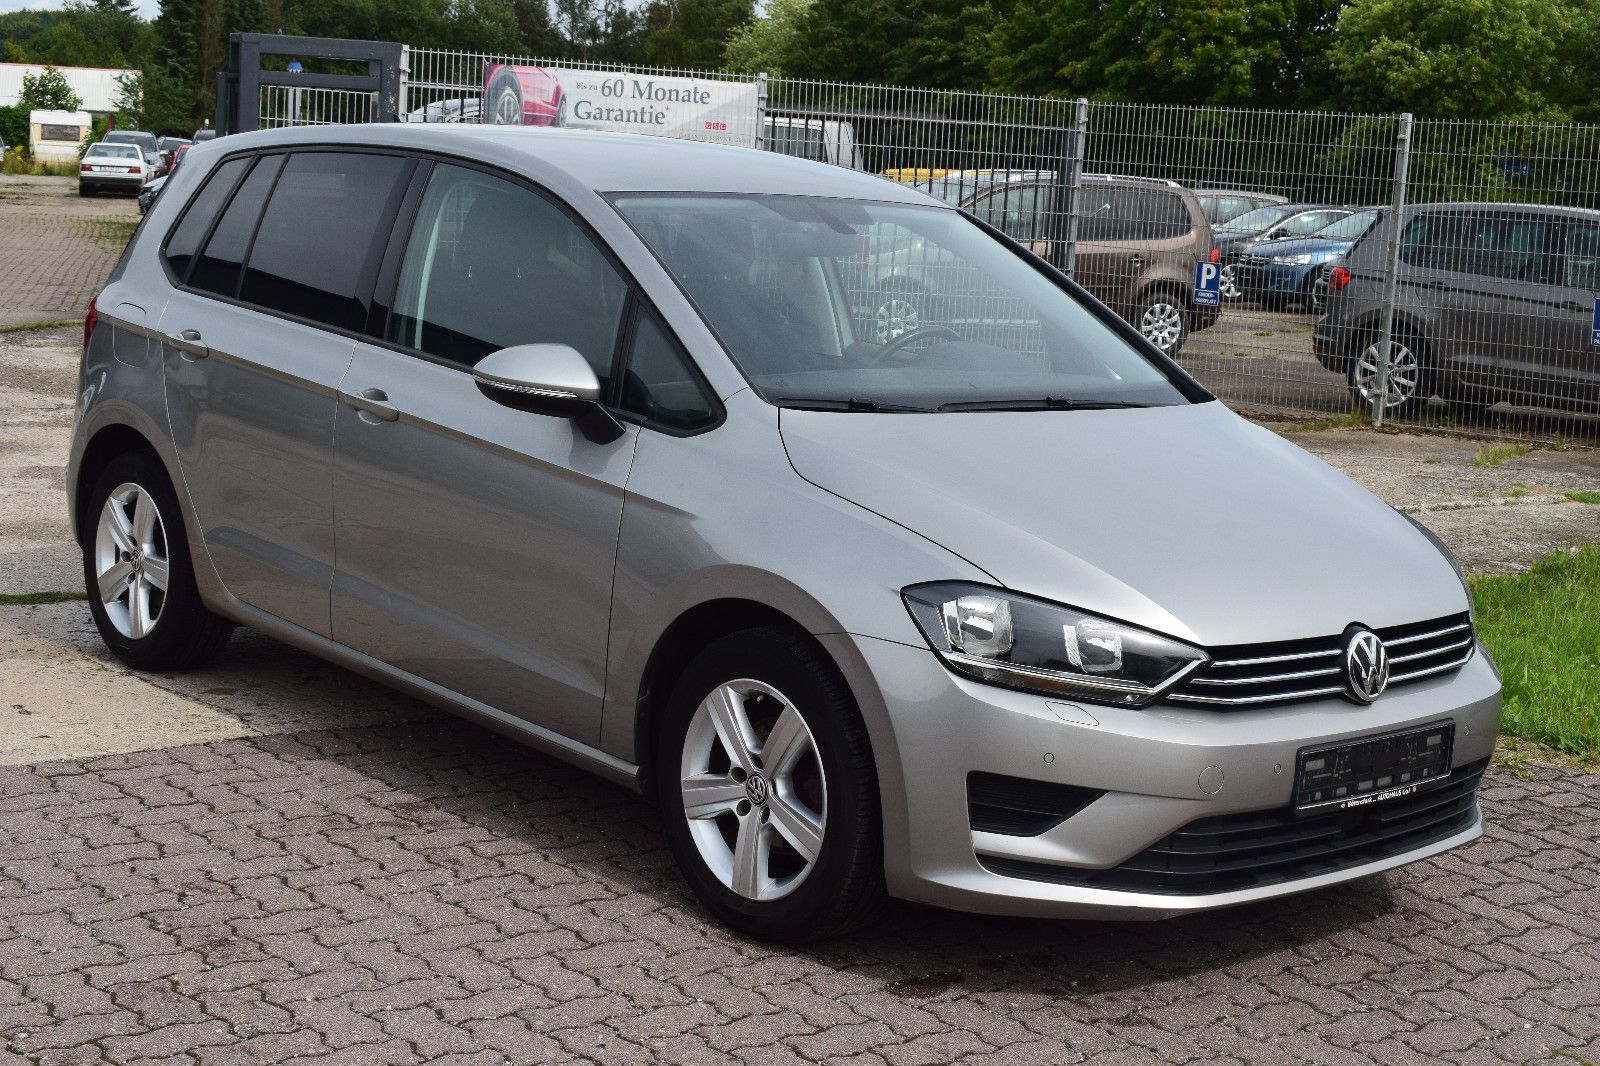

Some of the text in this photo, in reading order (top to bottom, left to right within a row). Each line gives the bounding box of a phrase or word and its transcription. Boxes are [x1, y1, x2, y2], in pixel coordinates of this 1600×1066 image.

[601, 78, 625, 98] 60
[630, 79, 711, 104] Monate
[1201, 263, 1217, 289] P
